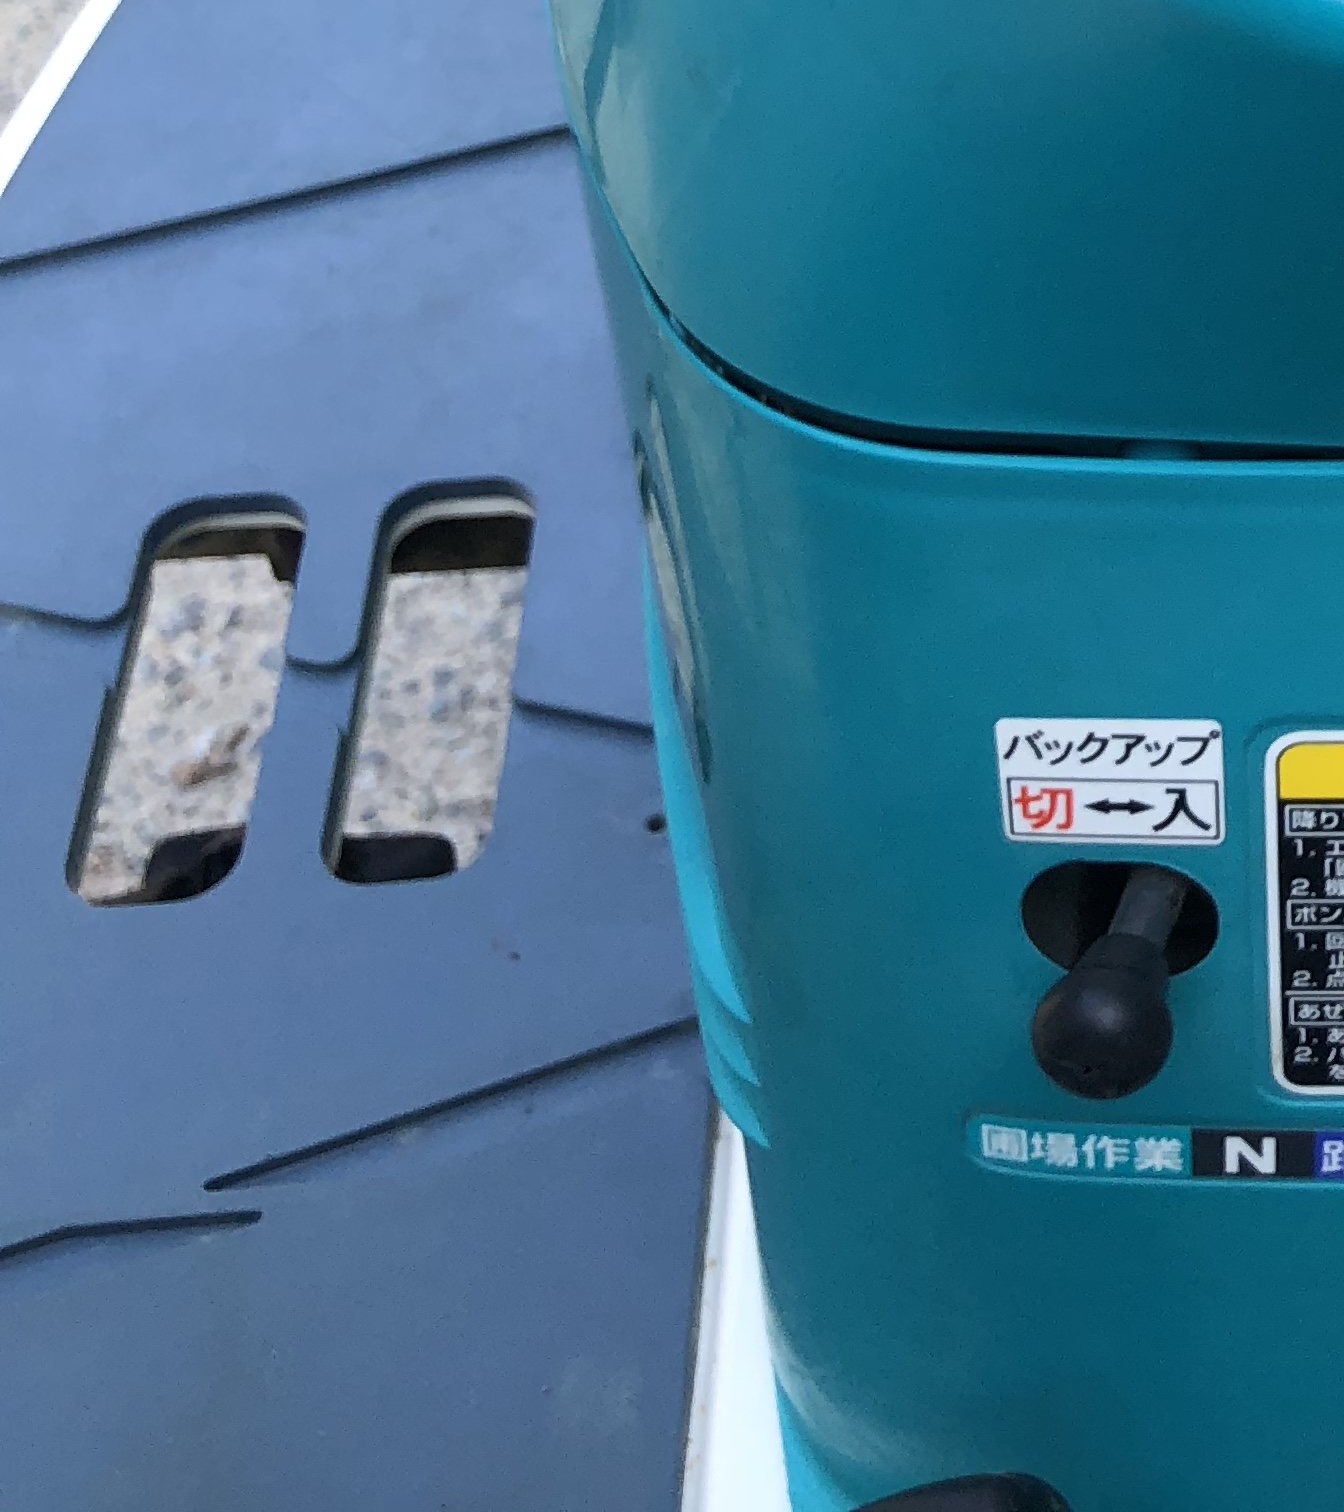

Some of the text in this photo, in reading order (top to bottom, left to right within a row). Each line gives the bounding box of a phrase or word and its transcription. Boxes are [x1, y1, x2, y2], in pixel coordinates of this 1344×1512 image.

[1003, 728, 1221, 767] バックアップ
[1013, 785, 1213, 832] 切 入
[981, 1122, 1184, 1172] 圃場作業
[1223, 1135, 1277, 1173] N
